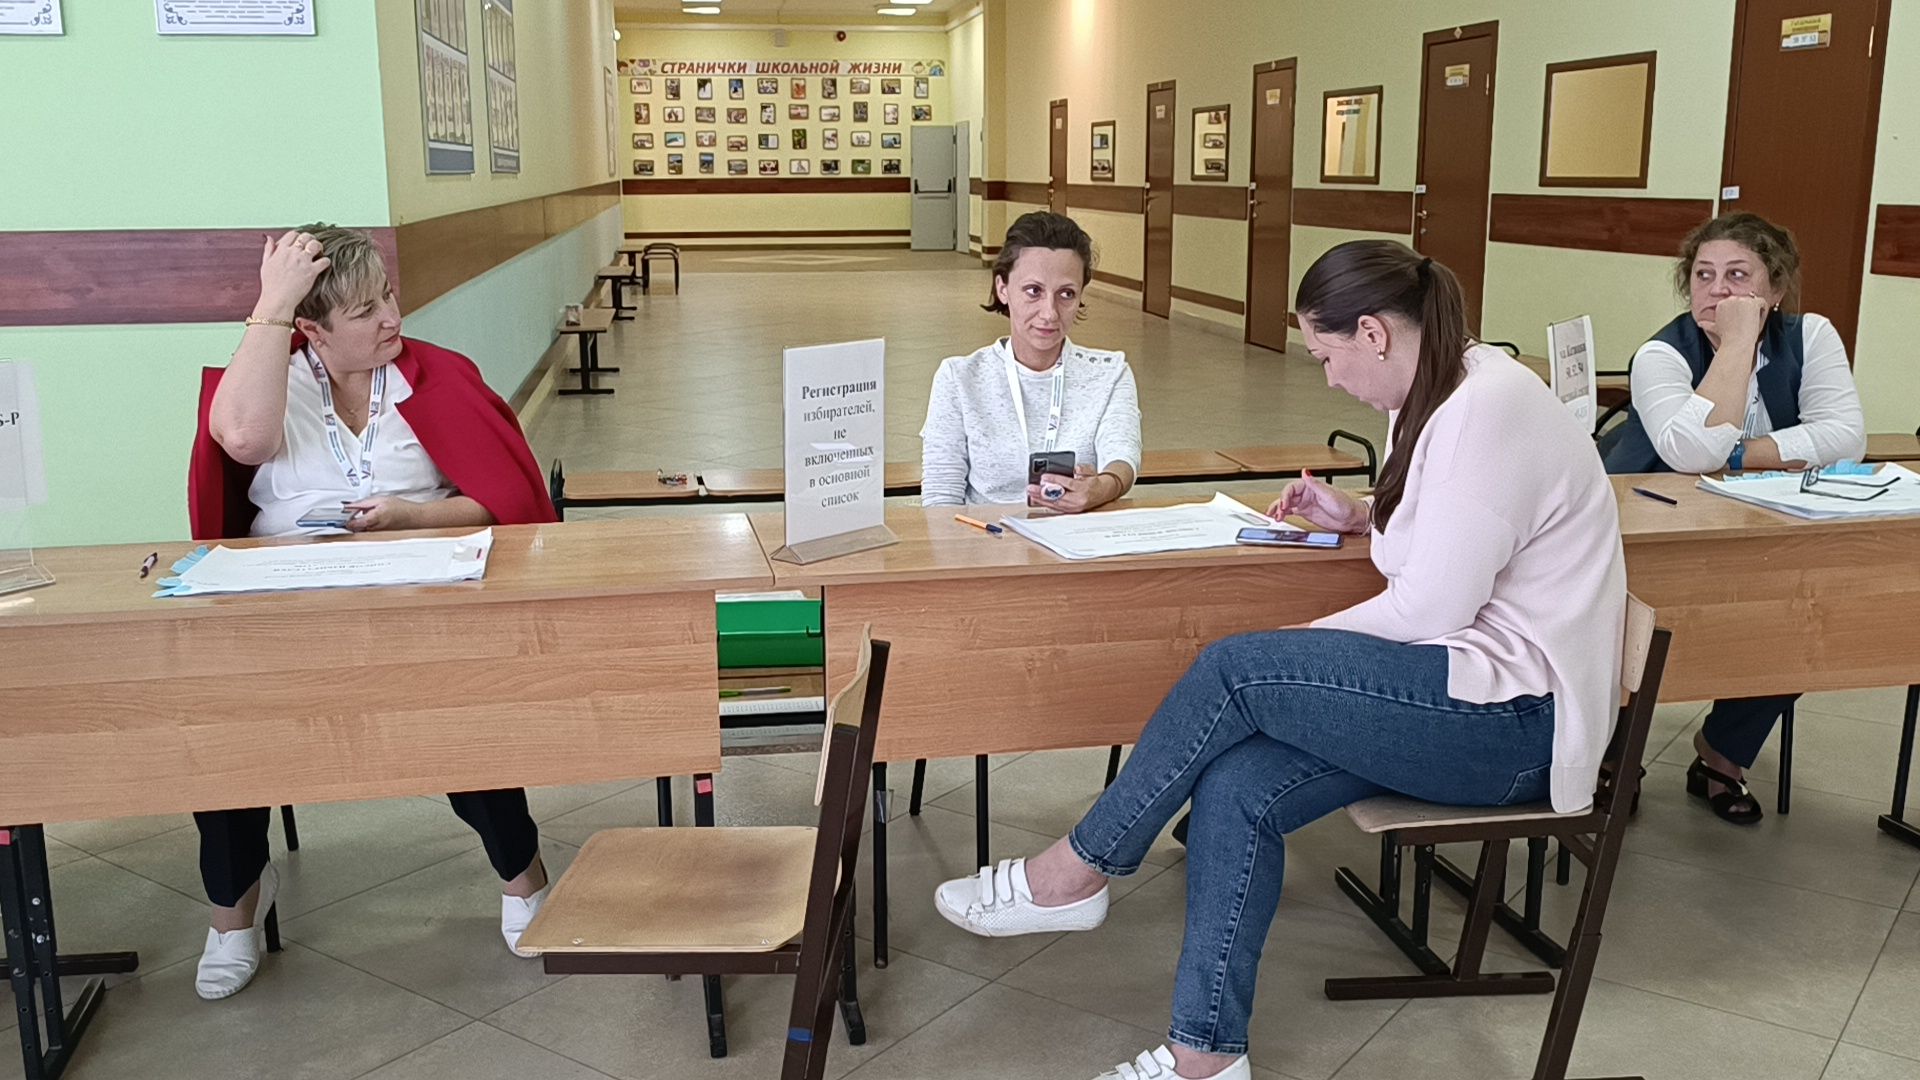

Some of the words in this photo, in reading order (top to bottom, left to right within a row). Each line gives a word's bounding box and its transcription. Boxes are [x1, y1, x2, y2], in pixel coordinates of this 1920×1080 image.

[660, 61, 748, 75] СТРАНИЧКИ
[755, 59, 840, 75] ШКОЛЬНОЙ
[847, 61, 903, 74] ЖИЗНИ
[802, 380, 877, 399] Регистрация
[833, 428, 847, 440] не
[804, 446, 874, 467] включенных
[808, 478, 816, 488] в
[818, 465, 870, 487] основной
[821, 491, 860, 508] список
